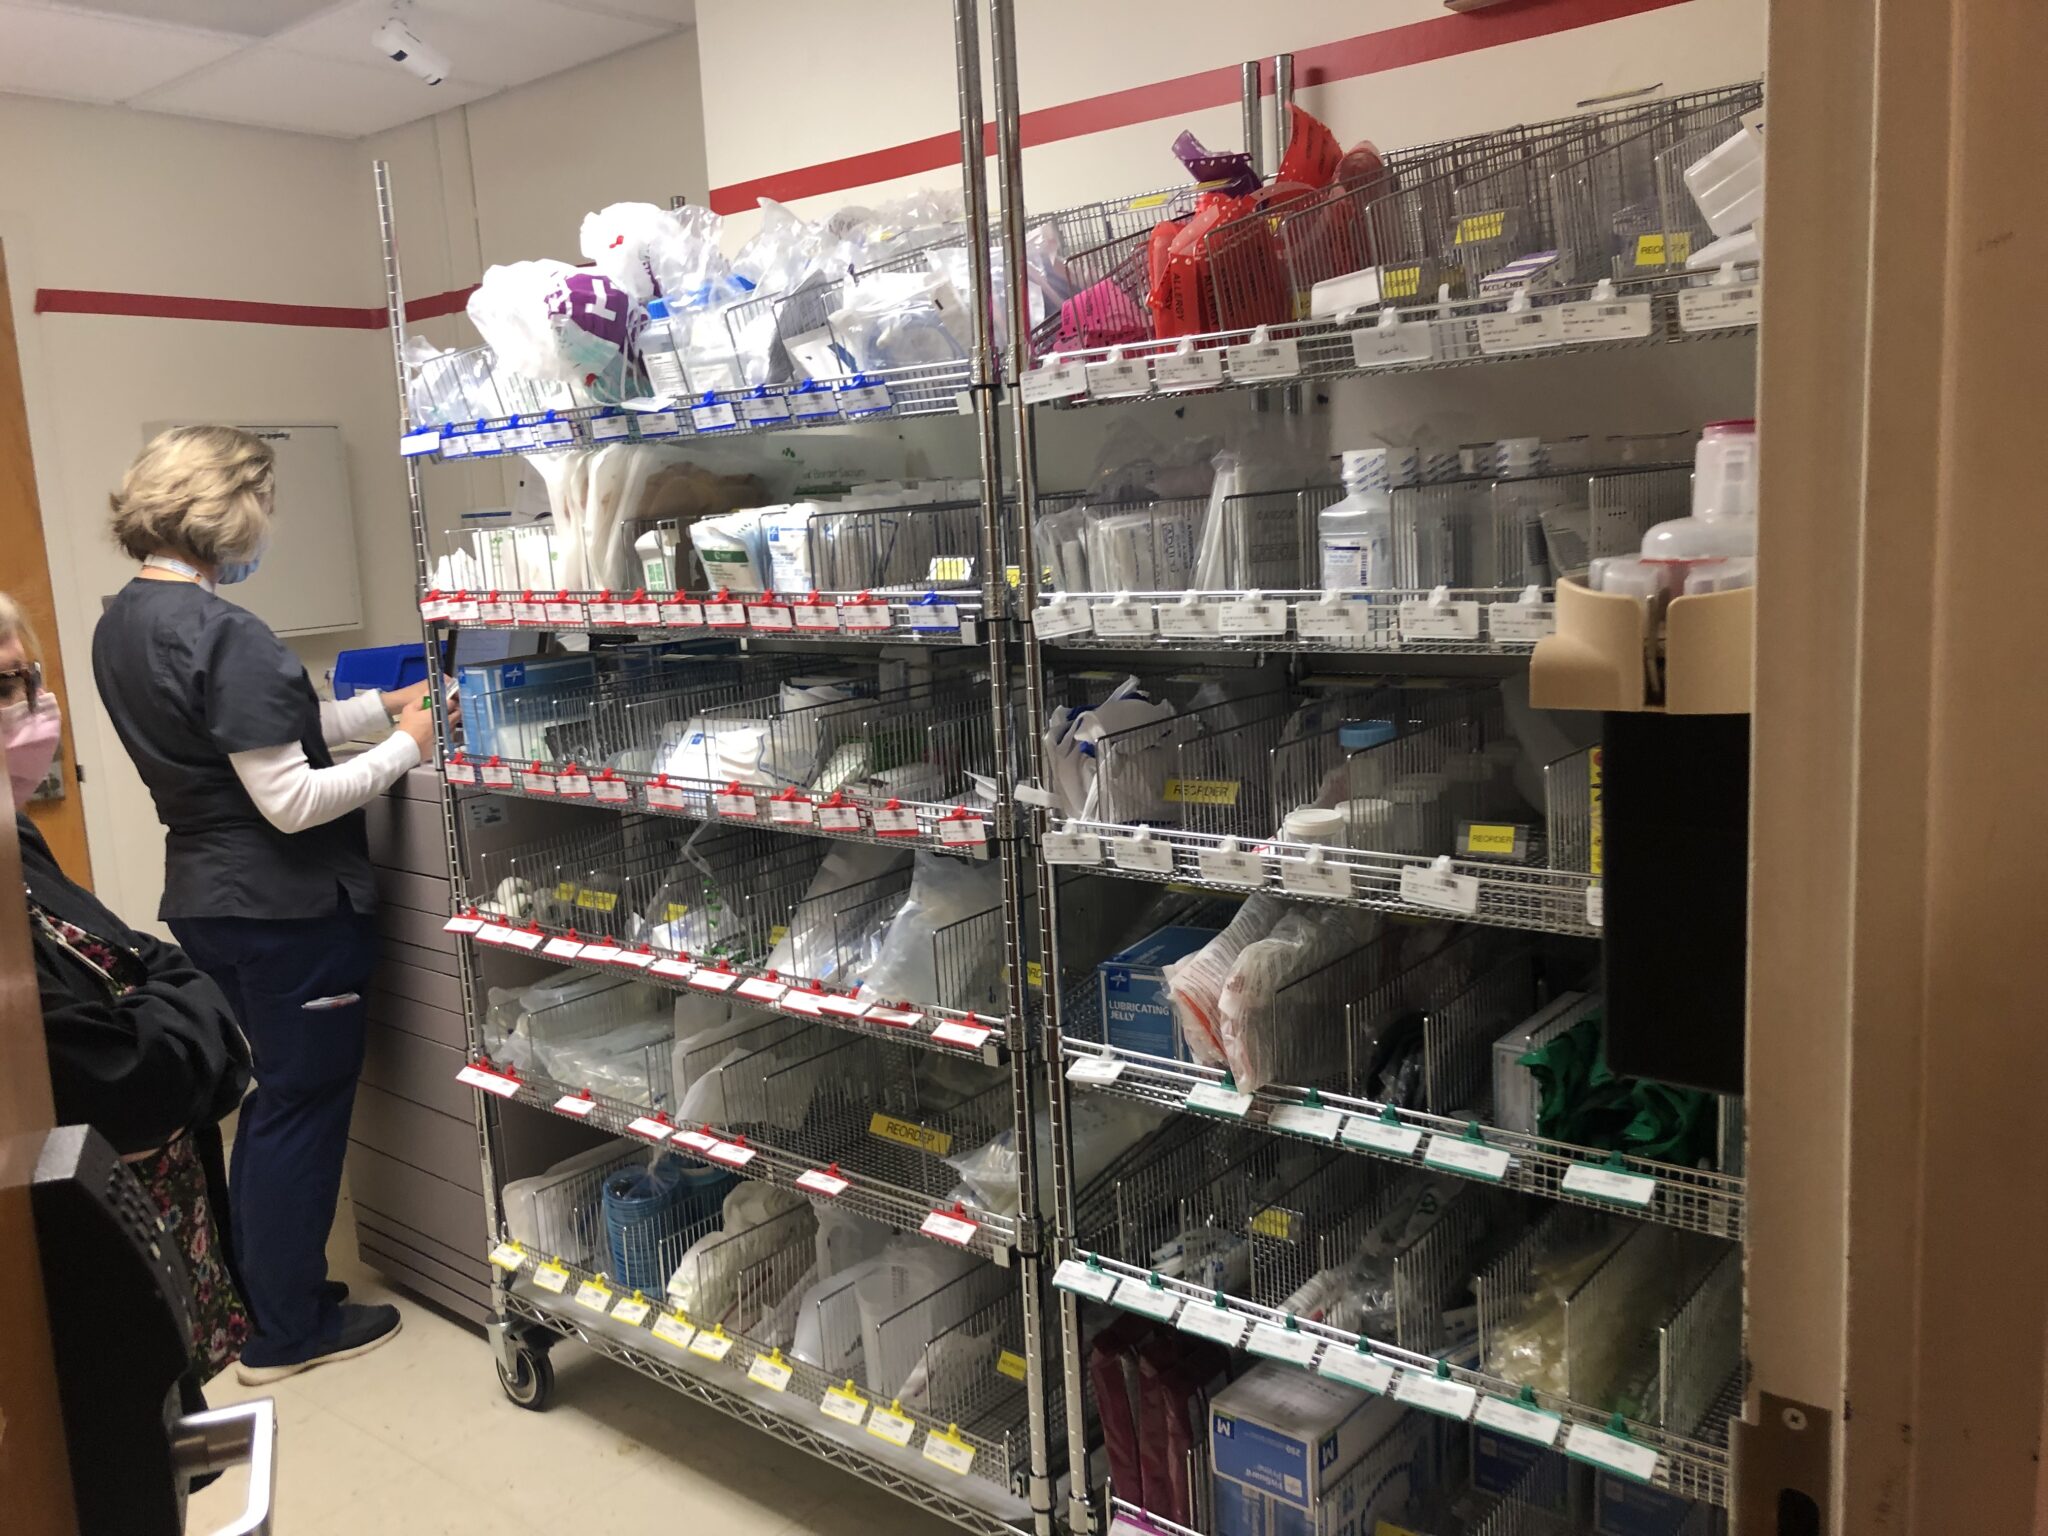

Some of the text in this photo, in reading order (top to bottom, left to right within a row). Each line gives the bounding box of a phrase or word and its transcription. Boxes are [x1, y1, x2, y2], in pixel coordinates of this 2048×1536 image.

[1173, 273, 1184, 320] ALLERGY
[1173, 784, 1229, 797] REORDER
[1108, 1000, 1169, 1016] LUBRICATING
[1110, 1010, 1135, 1021] JELLY
